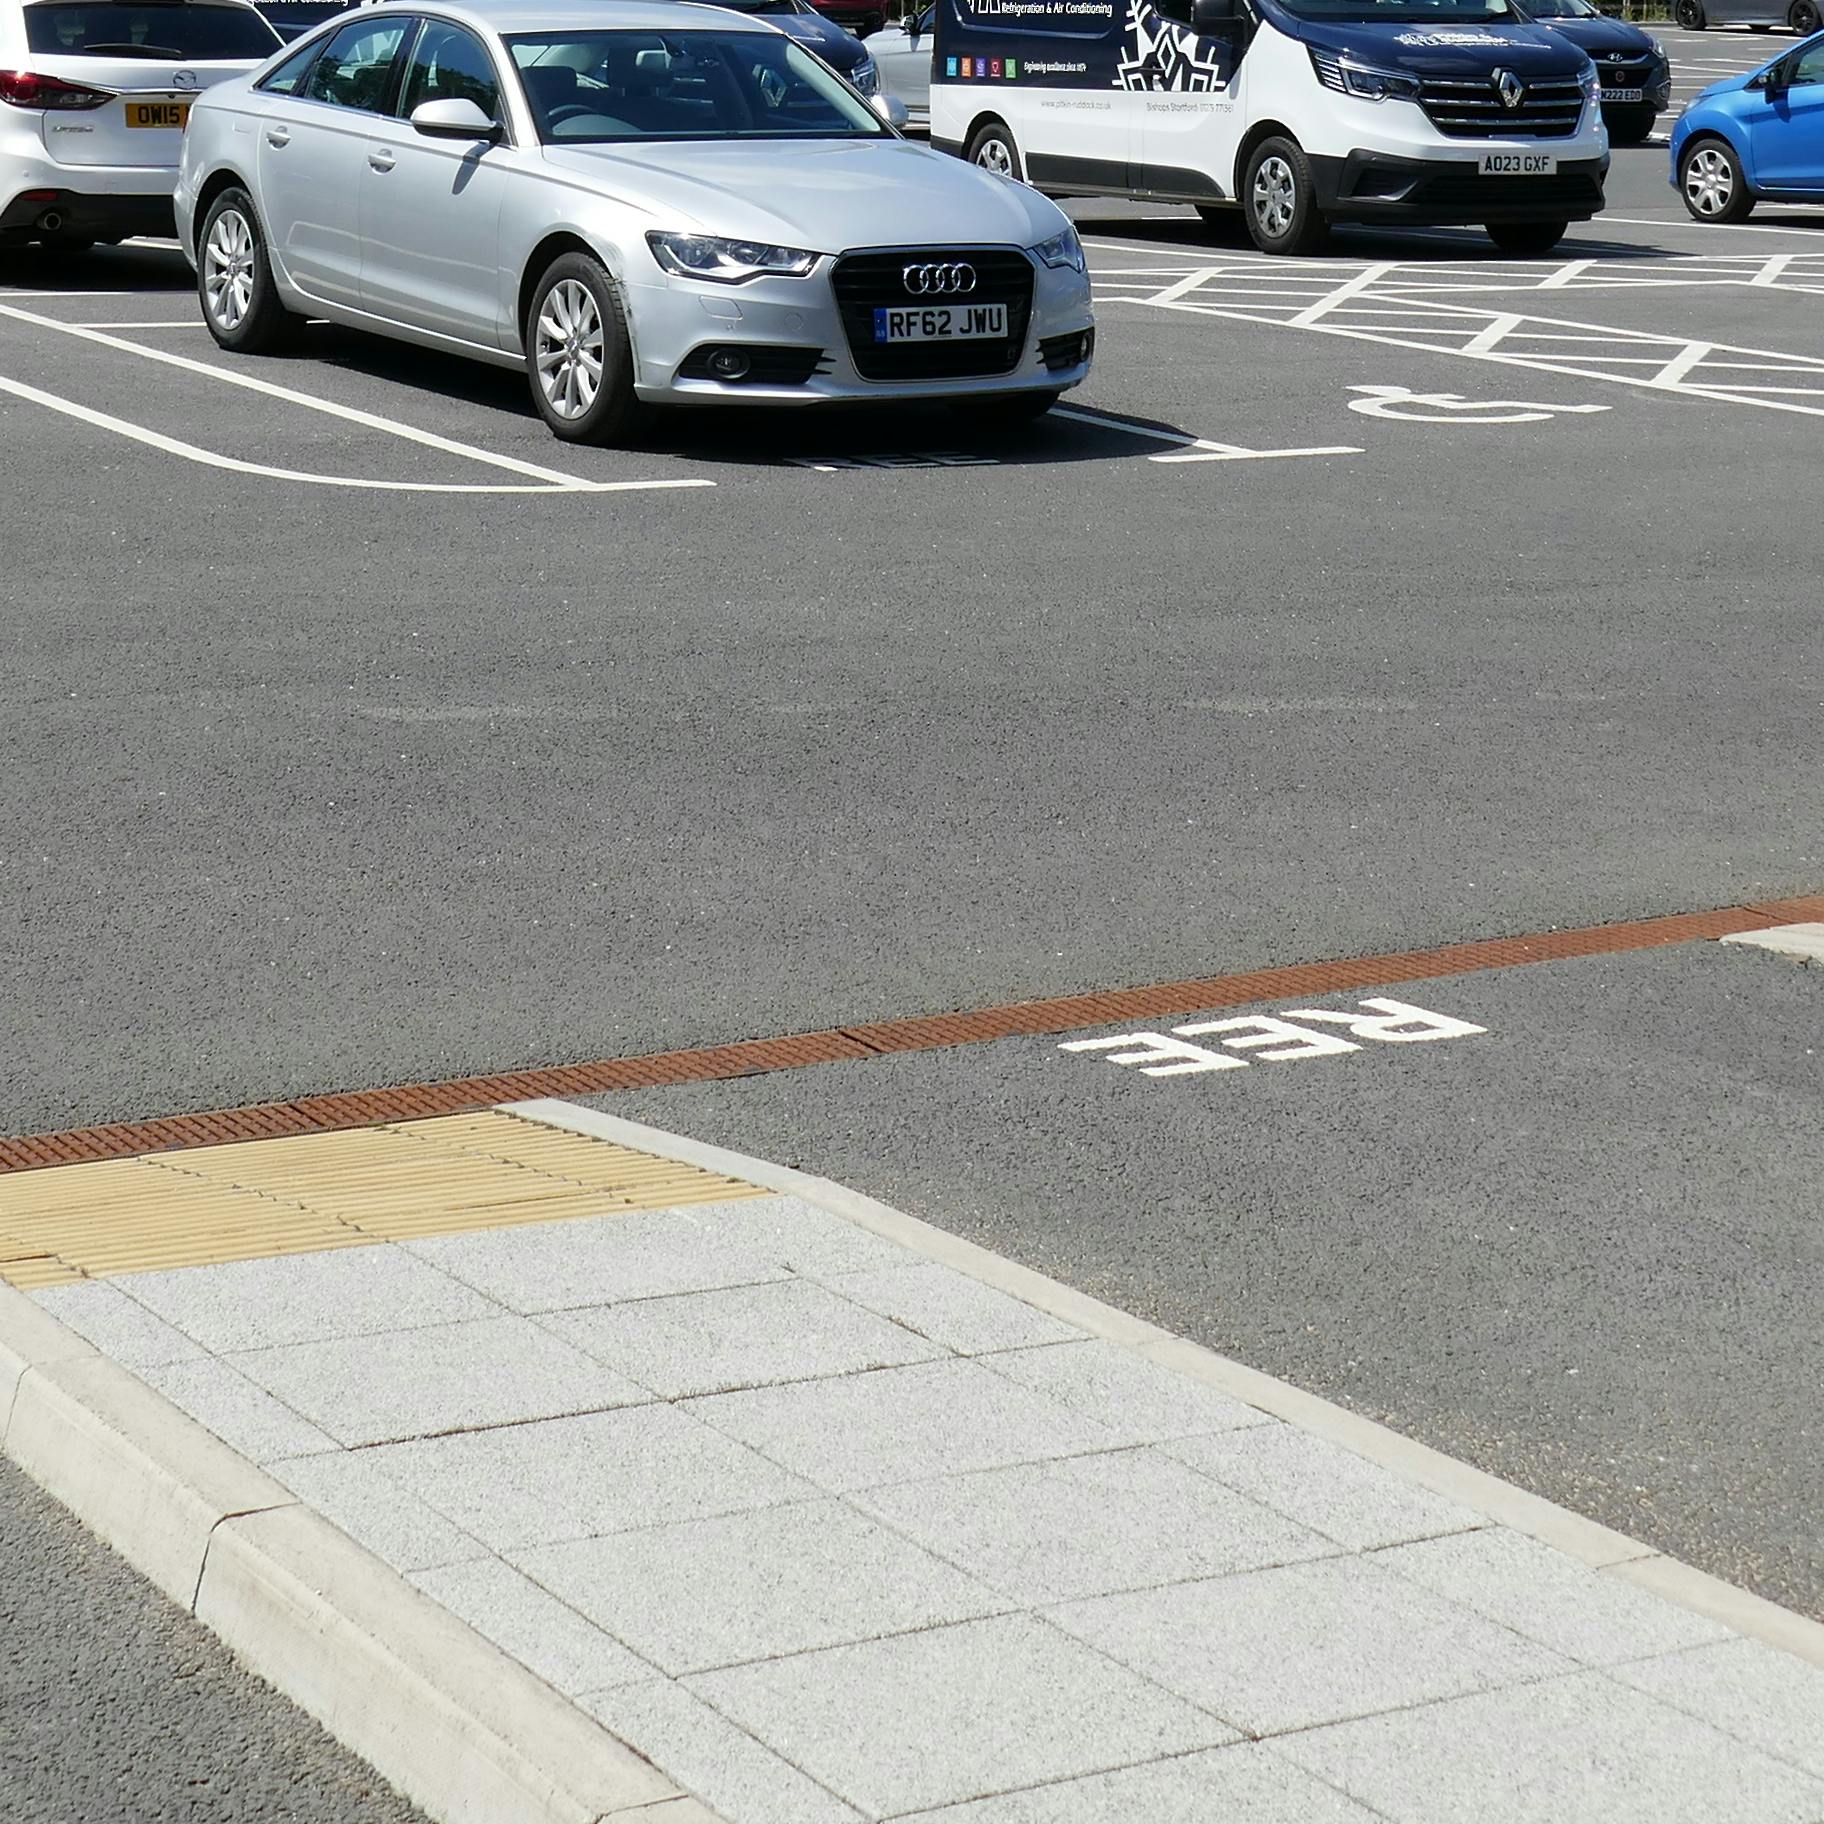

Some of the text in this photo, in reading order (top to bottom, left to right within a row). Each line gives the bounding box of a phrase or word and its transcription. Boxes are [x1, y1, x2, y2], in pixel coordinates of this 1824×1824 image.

[1002, 2, 1113, 17] Refrigeration & Air Conditioning
[138, 106, 180, 124] OW15
[1524, 156, 1550, 171] GXF
[889, 308, 1002, 337] RF62 JWU
[1057, 997, 1488, 1076] REE
